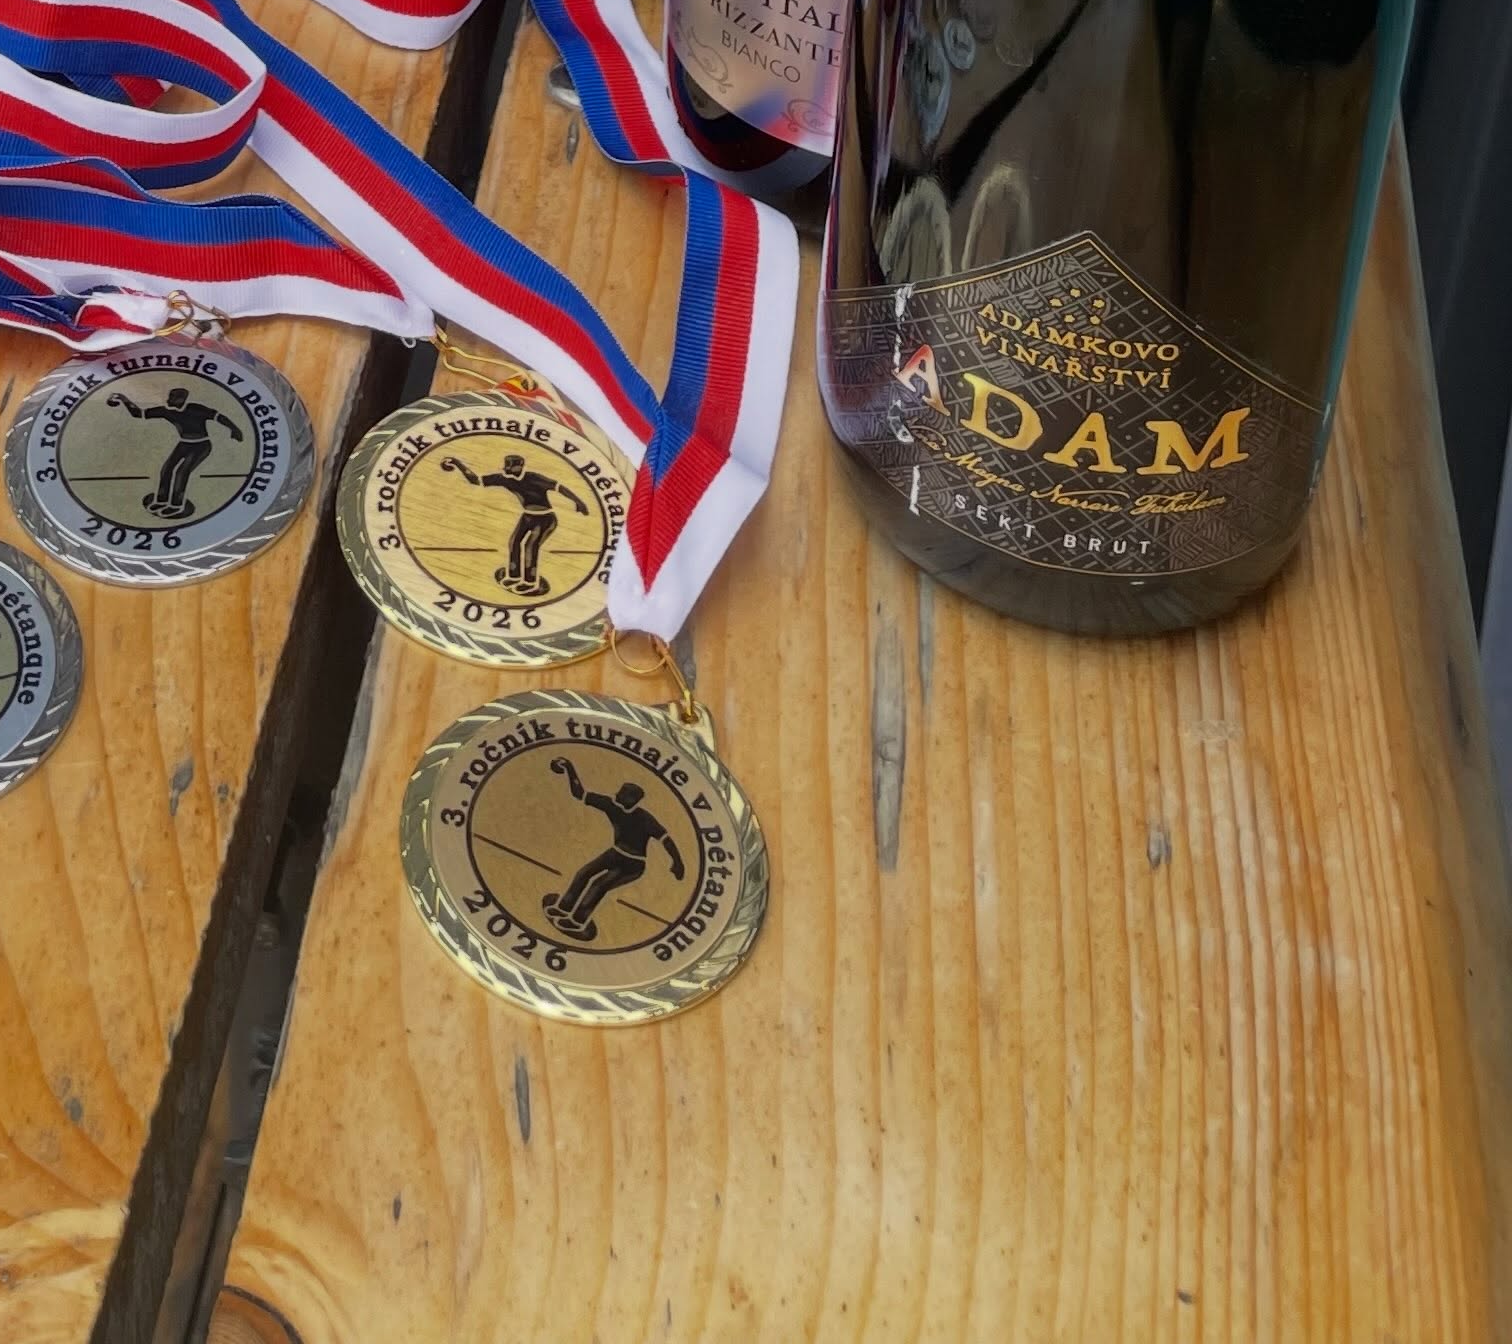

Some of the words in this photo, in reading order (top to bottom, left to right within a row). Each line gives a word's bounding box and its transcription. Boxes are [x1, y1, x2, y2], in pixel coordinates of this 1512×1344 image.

[720, 30, 801, 83] BIANCO
[976, 326, 1173, 392] VINAŘSTVÍ
[977, 303, 1180, 363] ADÁMKOVO
[36, 457, 58, 483] 3.
[106, 353, 218, 377] turnaje
[226, 372, 245, 387] v
[240, 388, 281, 505] pétanque
[893, 344, 1252, 476] ADAM
[378, 524, 403, 552] 3.
[434, 417, 551, 443] turnaje
[562, 441, 581, 456] v
[79, 517, 182, 551] 2026
[954, 493, 1036, 539] SEKT
[1063, 534, 1151, 555] BRUT
[433, 590, 542, 630] 2026
[565, 717, 689, 787] turnaje
[440, 799, 470, 829] 3.
[691, 792, 713, 813] v
[653, 824, 736, 964] pétanque
[462, 888, 570, 973] 2026
